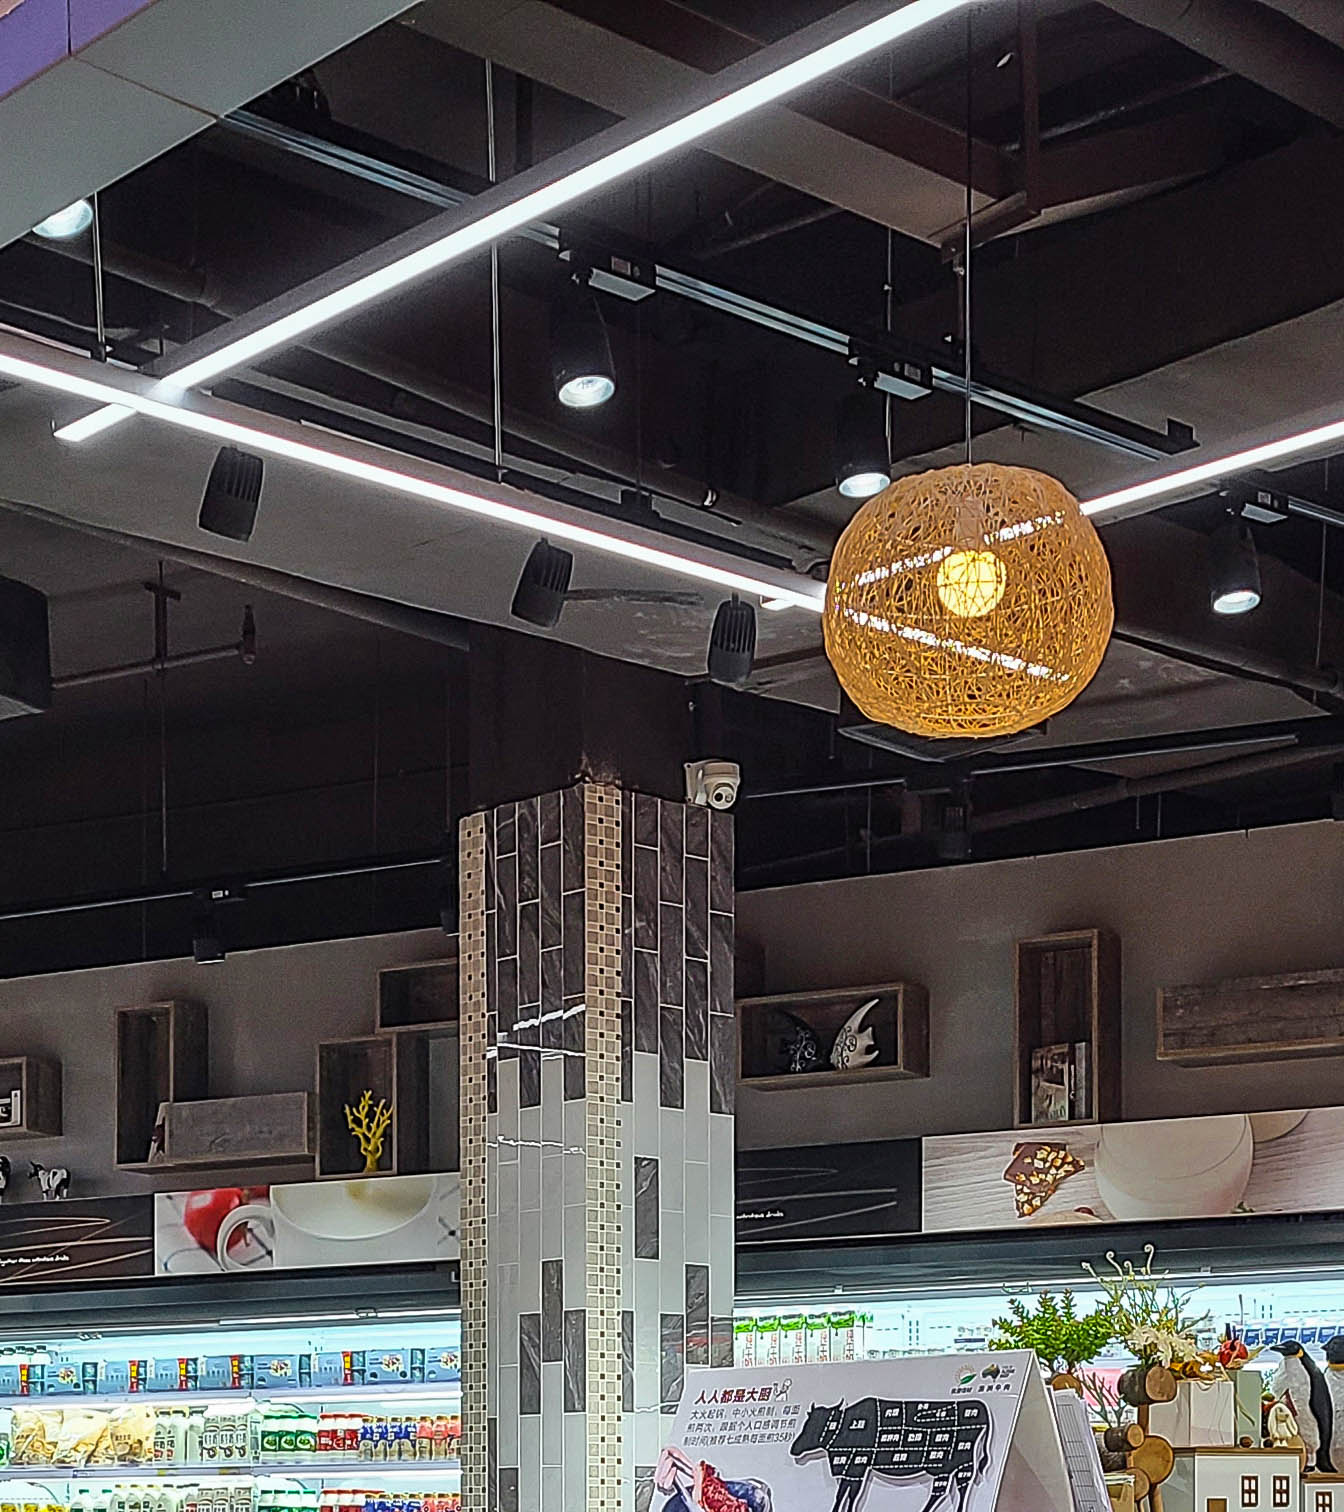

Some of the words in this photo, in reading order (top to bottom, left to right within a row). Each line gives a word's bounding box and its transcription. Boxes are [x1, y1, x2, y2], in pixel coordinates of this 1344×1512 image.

[694, 1387, 773, 1405] 人人都是大厨
